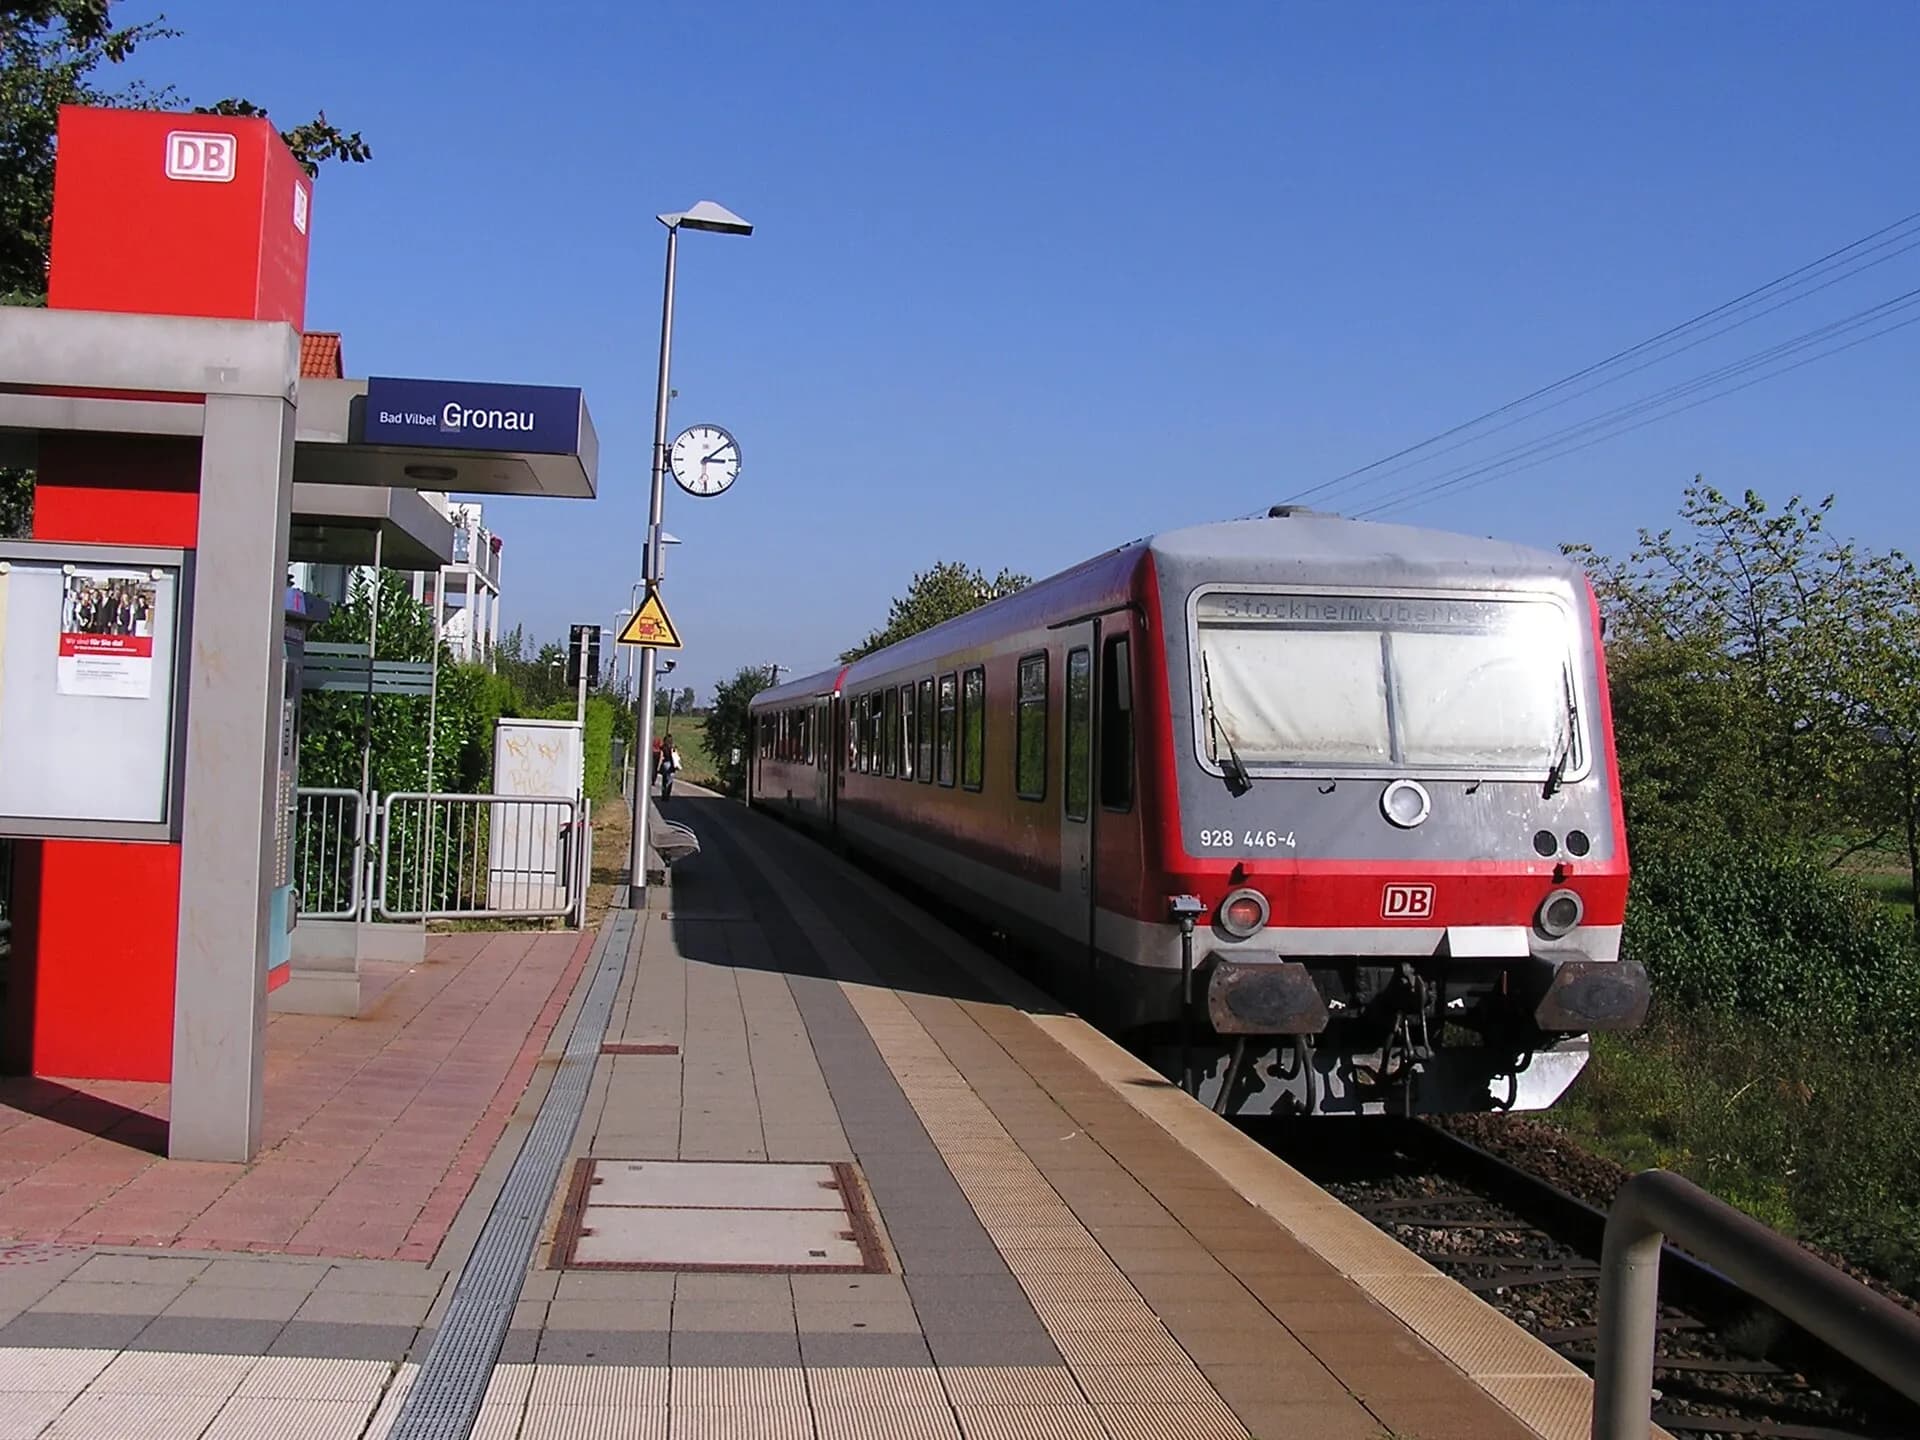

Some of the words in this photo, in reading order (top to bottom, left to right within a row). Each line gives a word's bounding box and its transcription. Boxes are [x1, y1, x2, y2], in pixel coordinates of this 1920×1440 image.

[176, 140, 226, 172] DB
[380, 411, 402, 424] Bad
[405, 413, 437, 426] Vilbel
[443, 402, 534, 430] Gronau
[1200, 829, 1234, 847] 928
[1243, 830, 1297, 849] 446-4
[1389, 889, 1428, 913] DB
